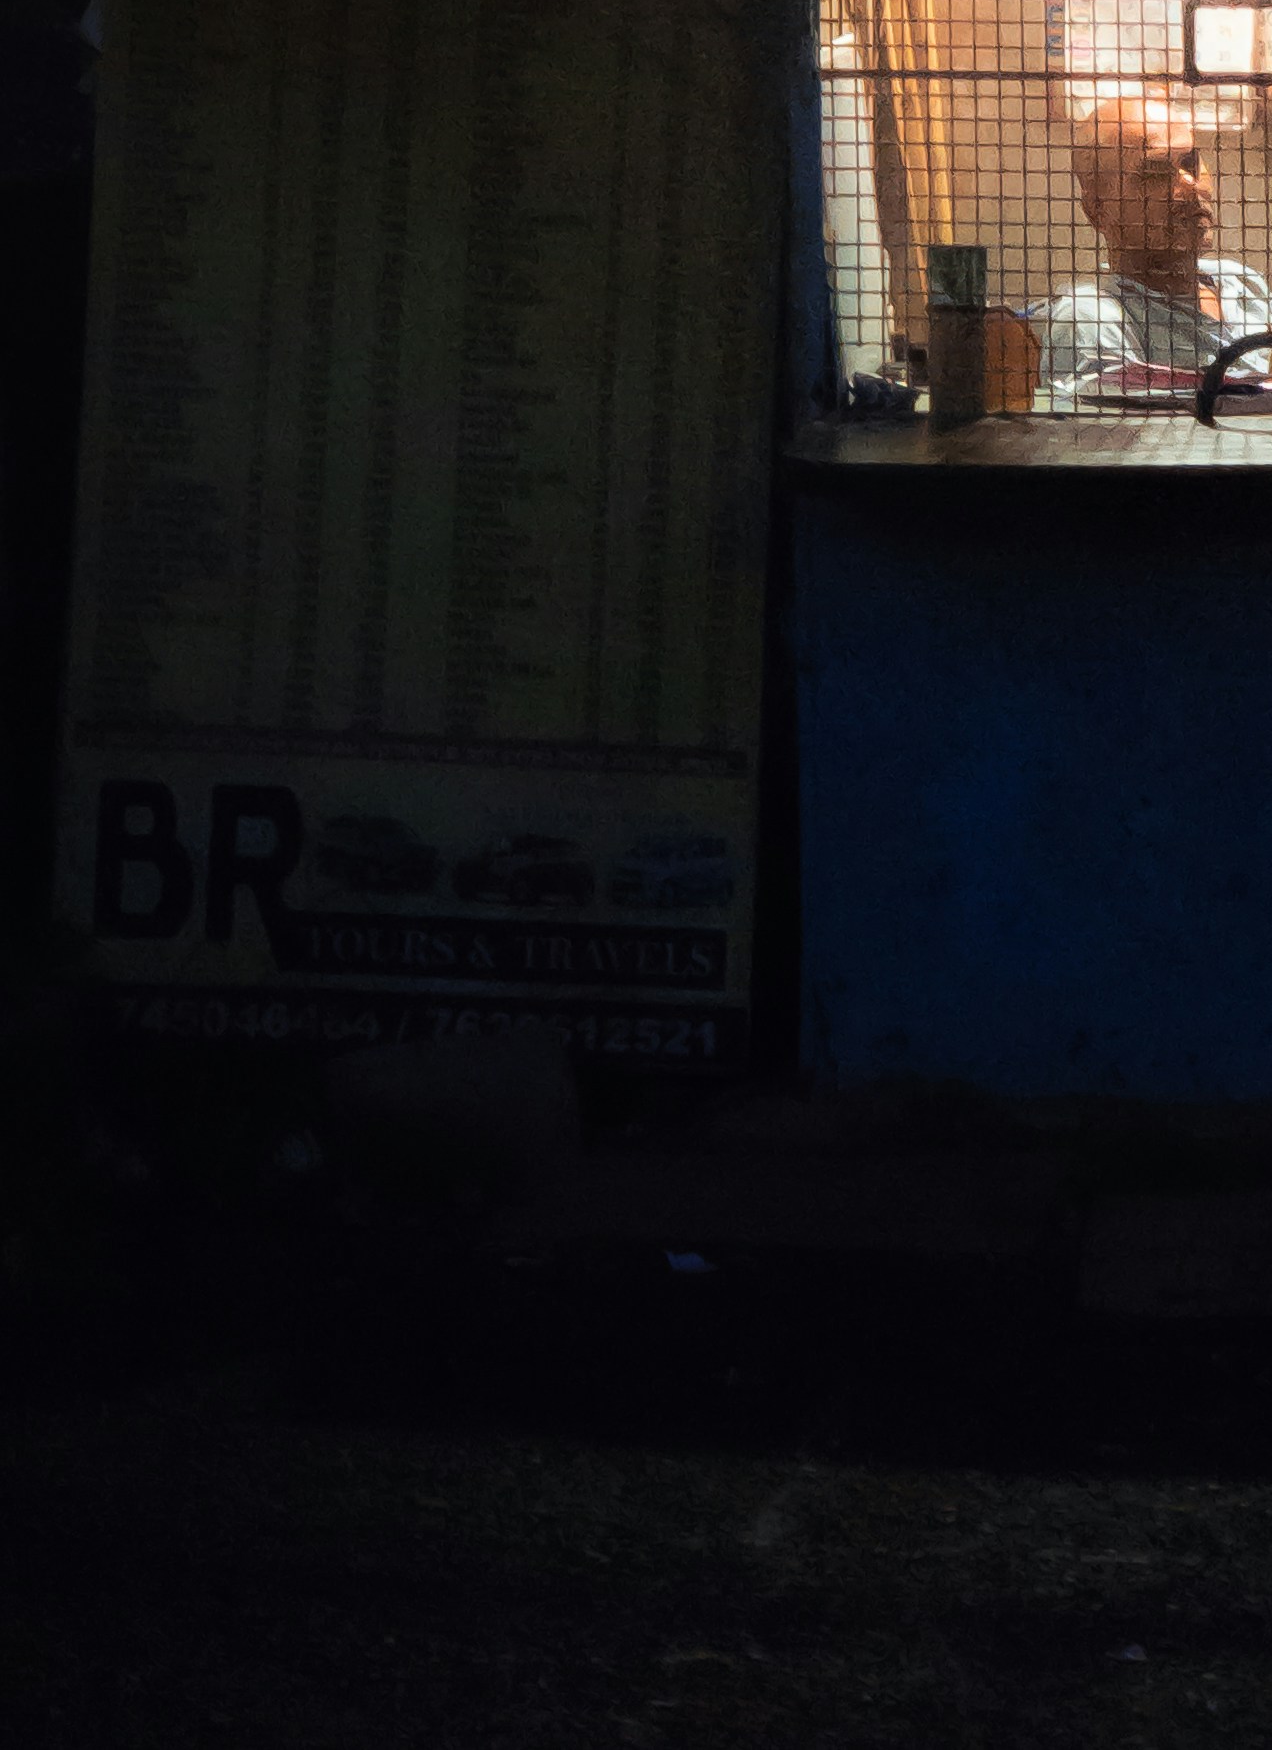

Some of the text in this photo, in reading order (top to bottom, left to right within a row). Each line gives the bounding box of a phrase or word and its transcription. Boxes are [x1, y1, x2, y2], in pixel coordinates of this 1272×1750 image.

[94, 779, 301, 972] BR
[303, 926, 715, 978] TOURS & TRAVELS
